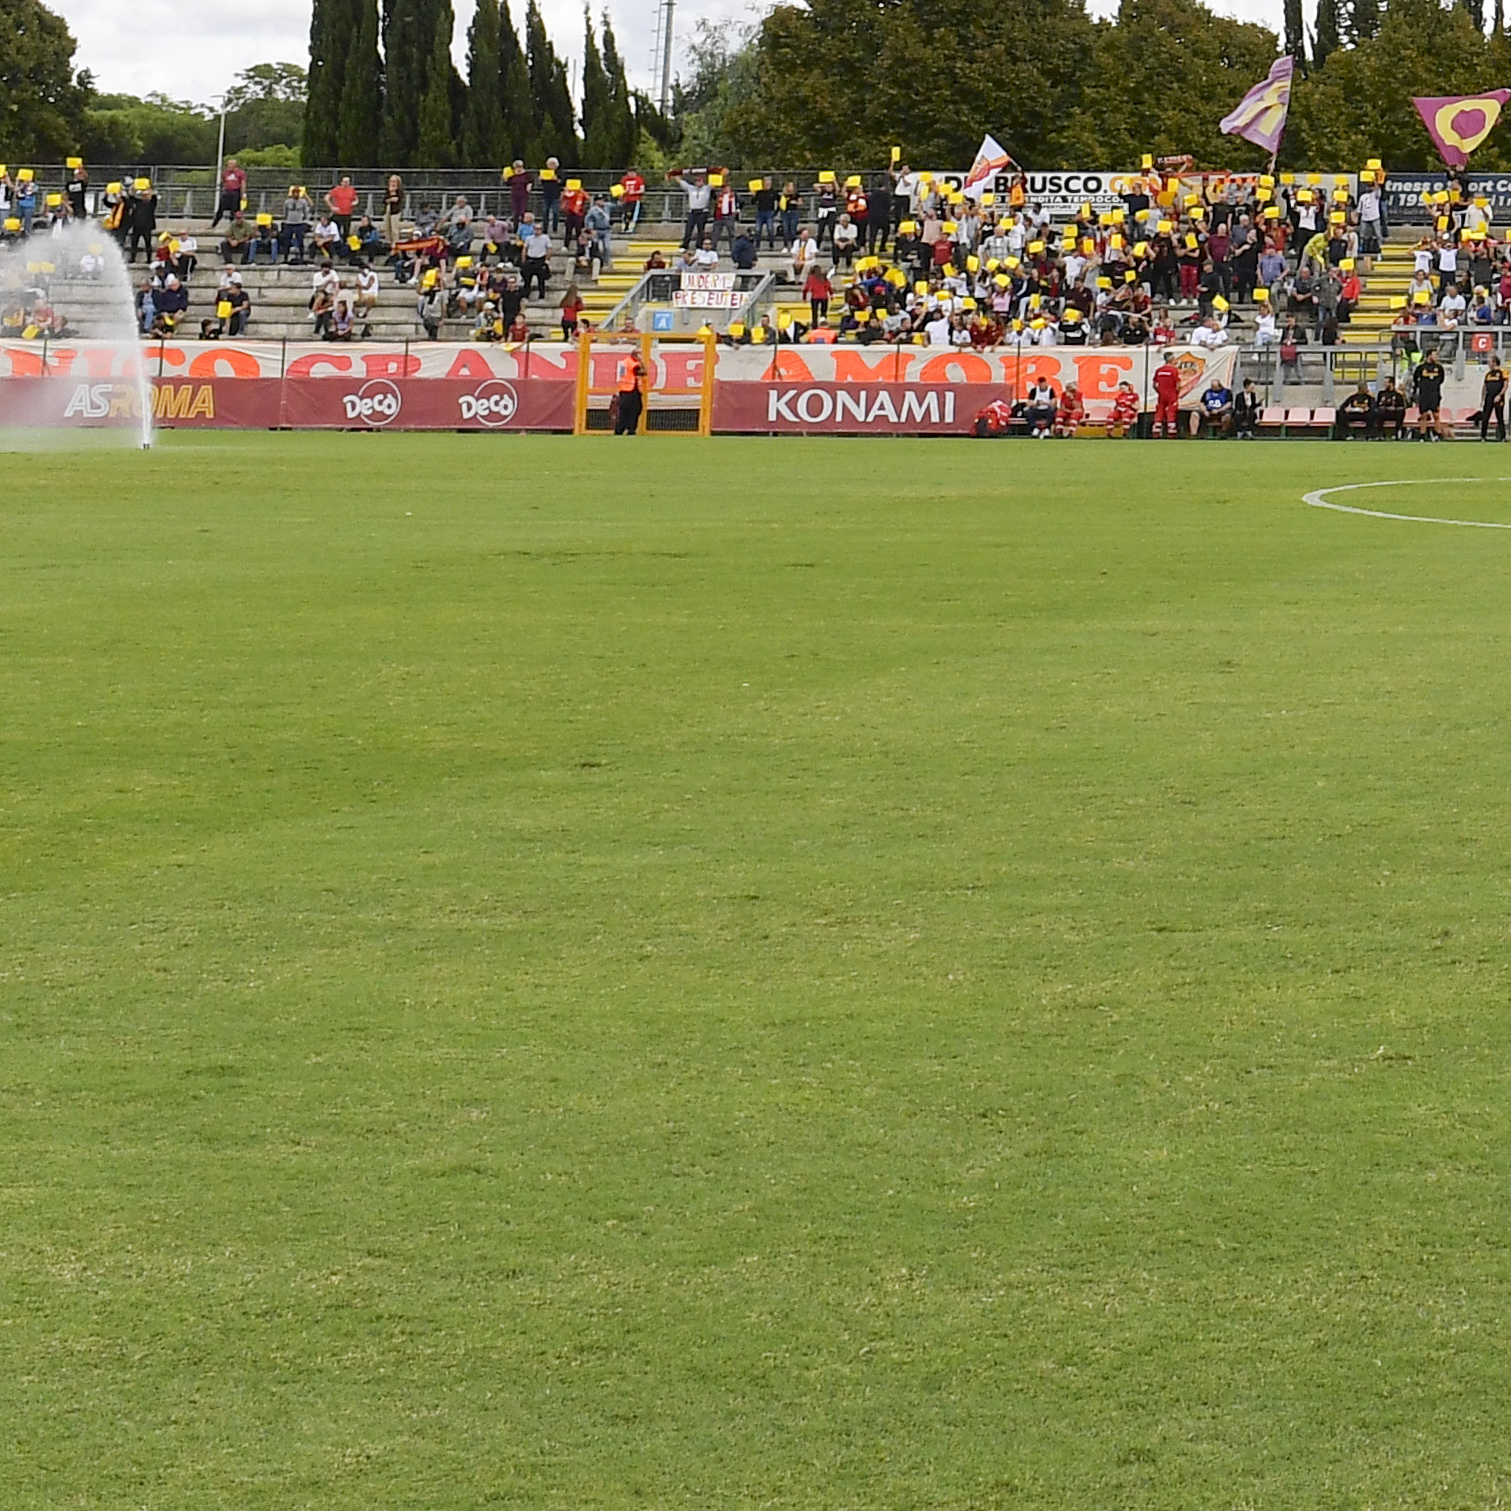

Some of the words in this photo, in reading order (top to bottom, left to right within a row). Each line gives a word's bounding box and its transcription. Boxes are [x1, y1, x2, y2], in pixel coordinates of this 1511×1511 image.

[1478, 337, 1487, 349] C
[0, 347, 260, 378] NICO
[761, 349, 1133, 400] AMORE
[768, 388, 954, 423] KONAMI
